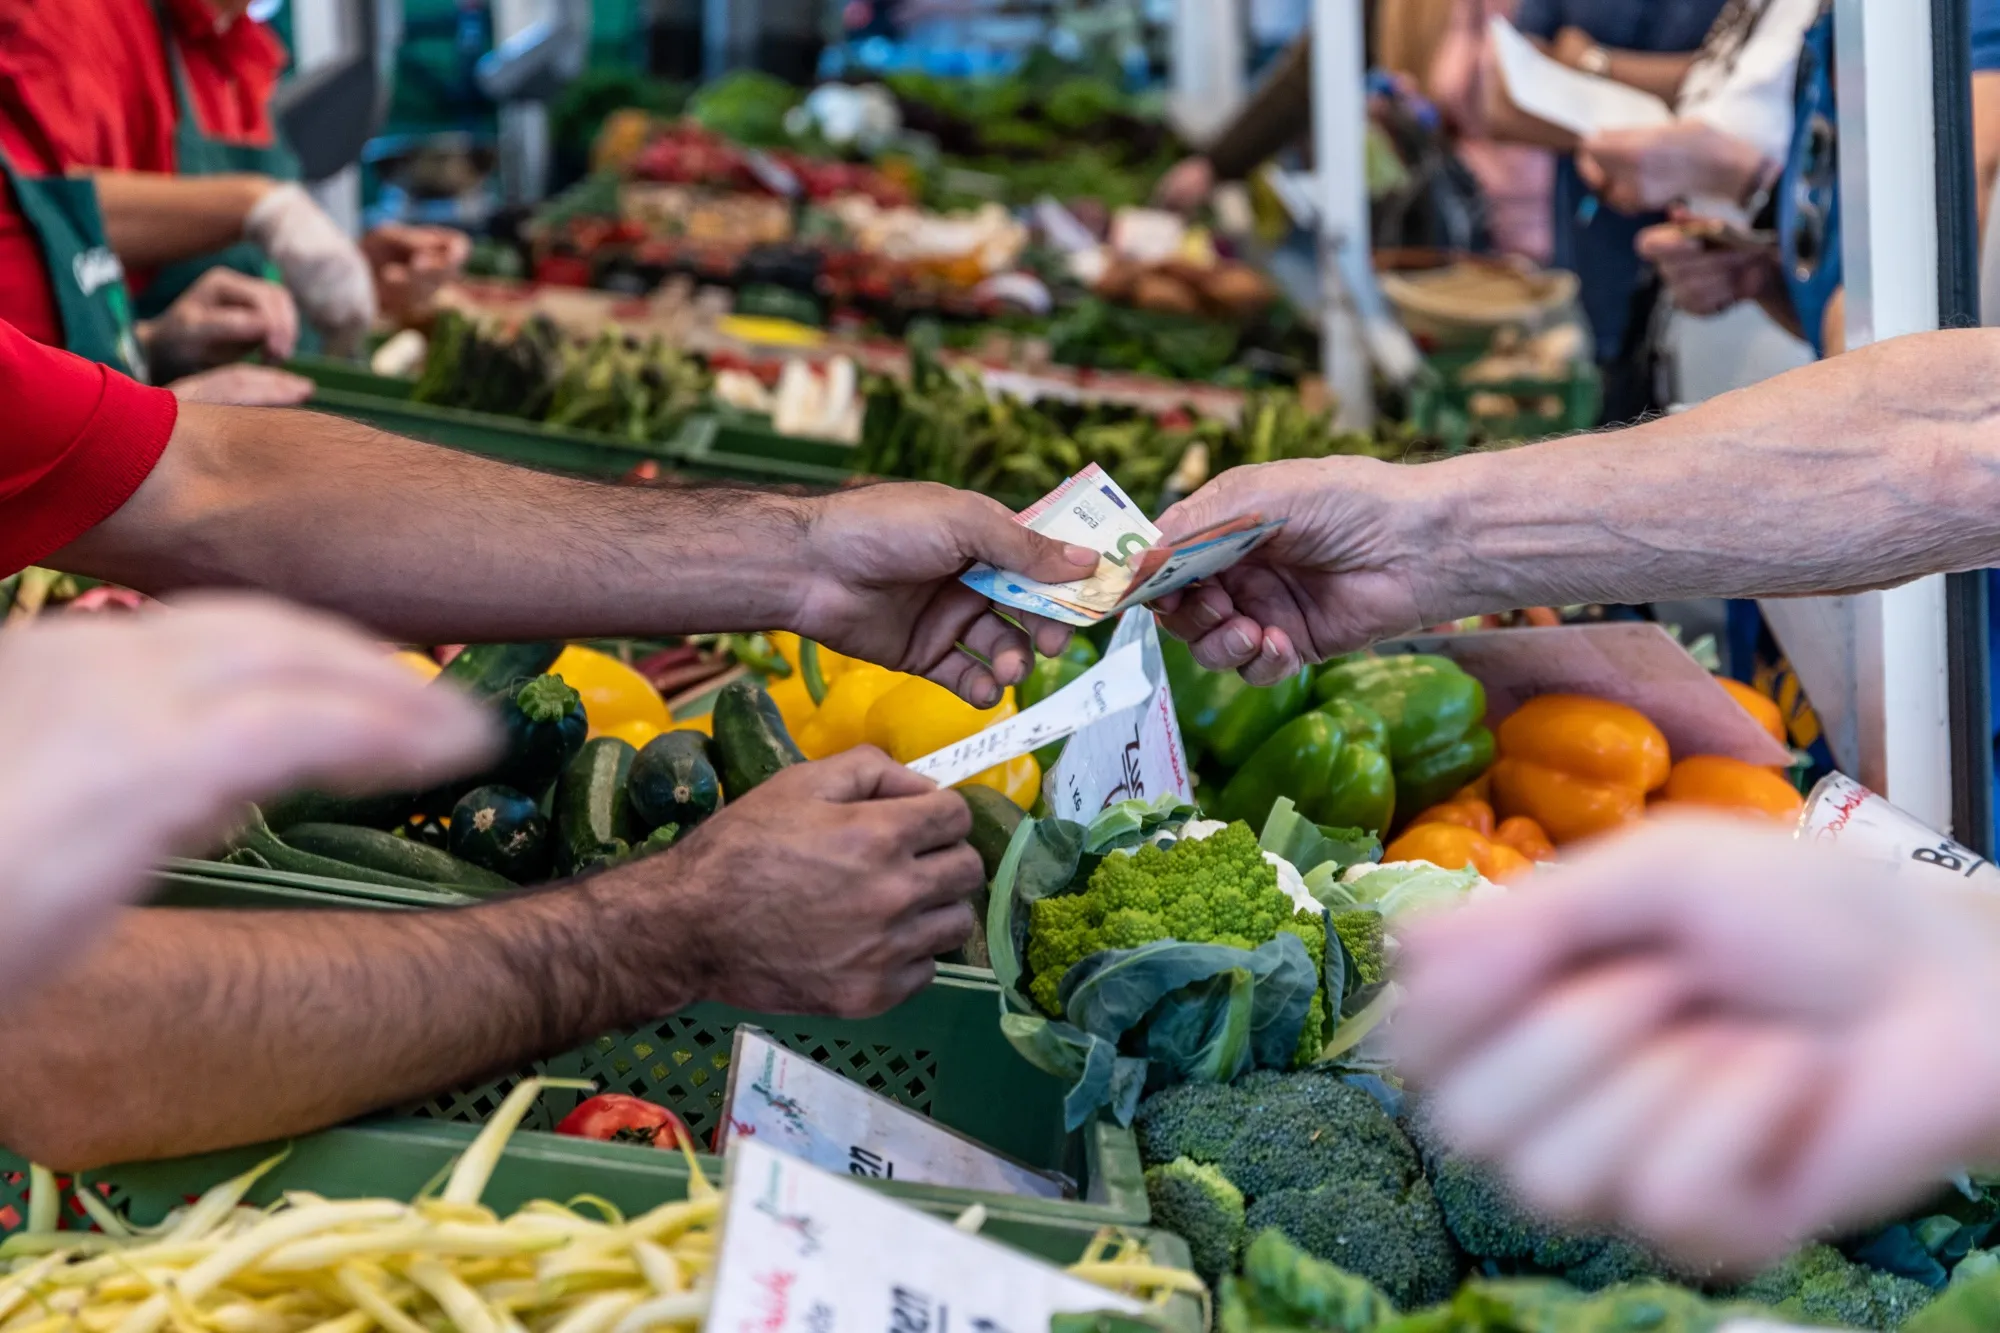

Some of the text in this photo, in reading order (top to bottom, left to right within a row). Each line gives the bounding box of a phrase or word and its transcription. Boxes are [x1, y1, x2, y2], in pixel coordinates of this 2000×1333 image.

[1072, 505, 1100, 530] EURO
[1103, 532, 1151, 567] 5
[1068, 774, 1077, 787] 1
